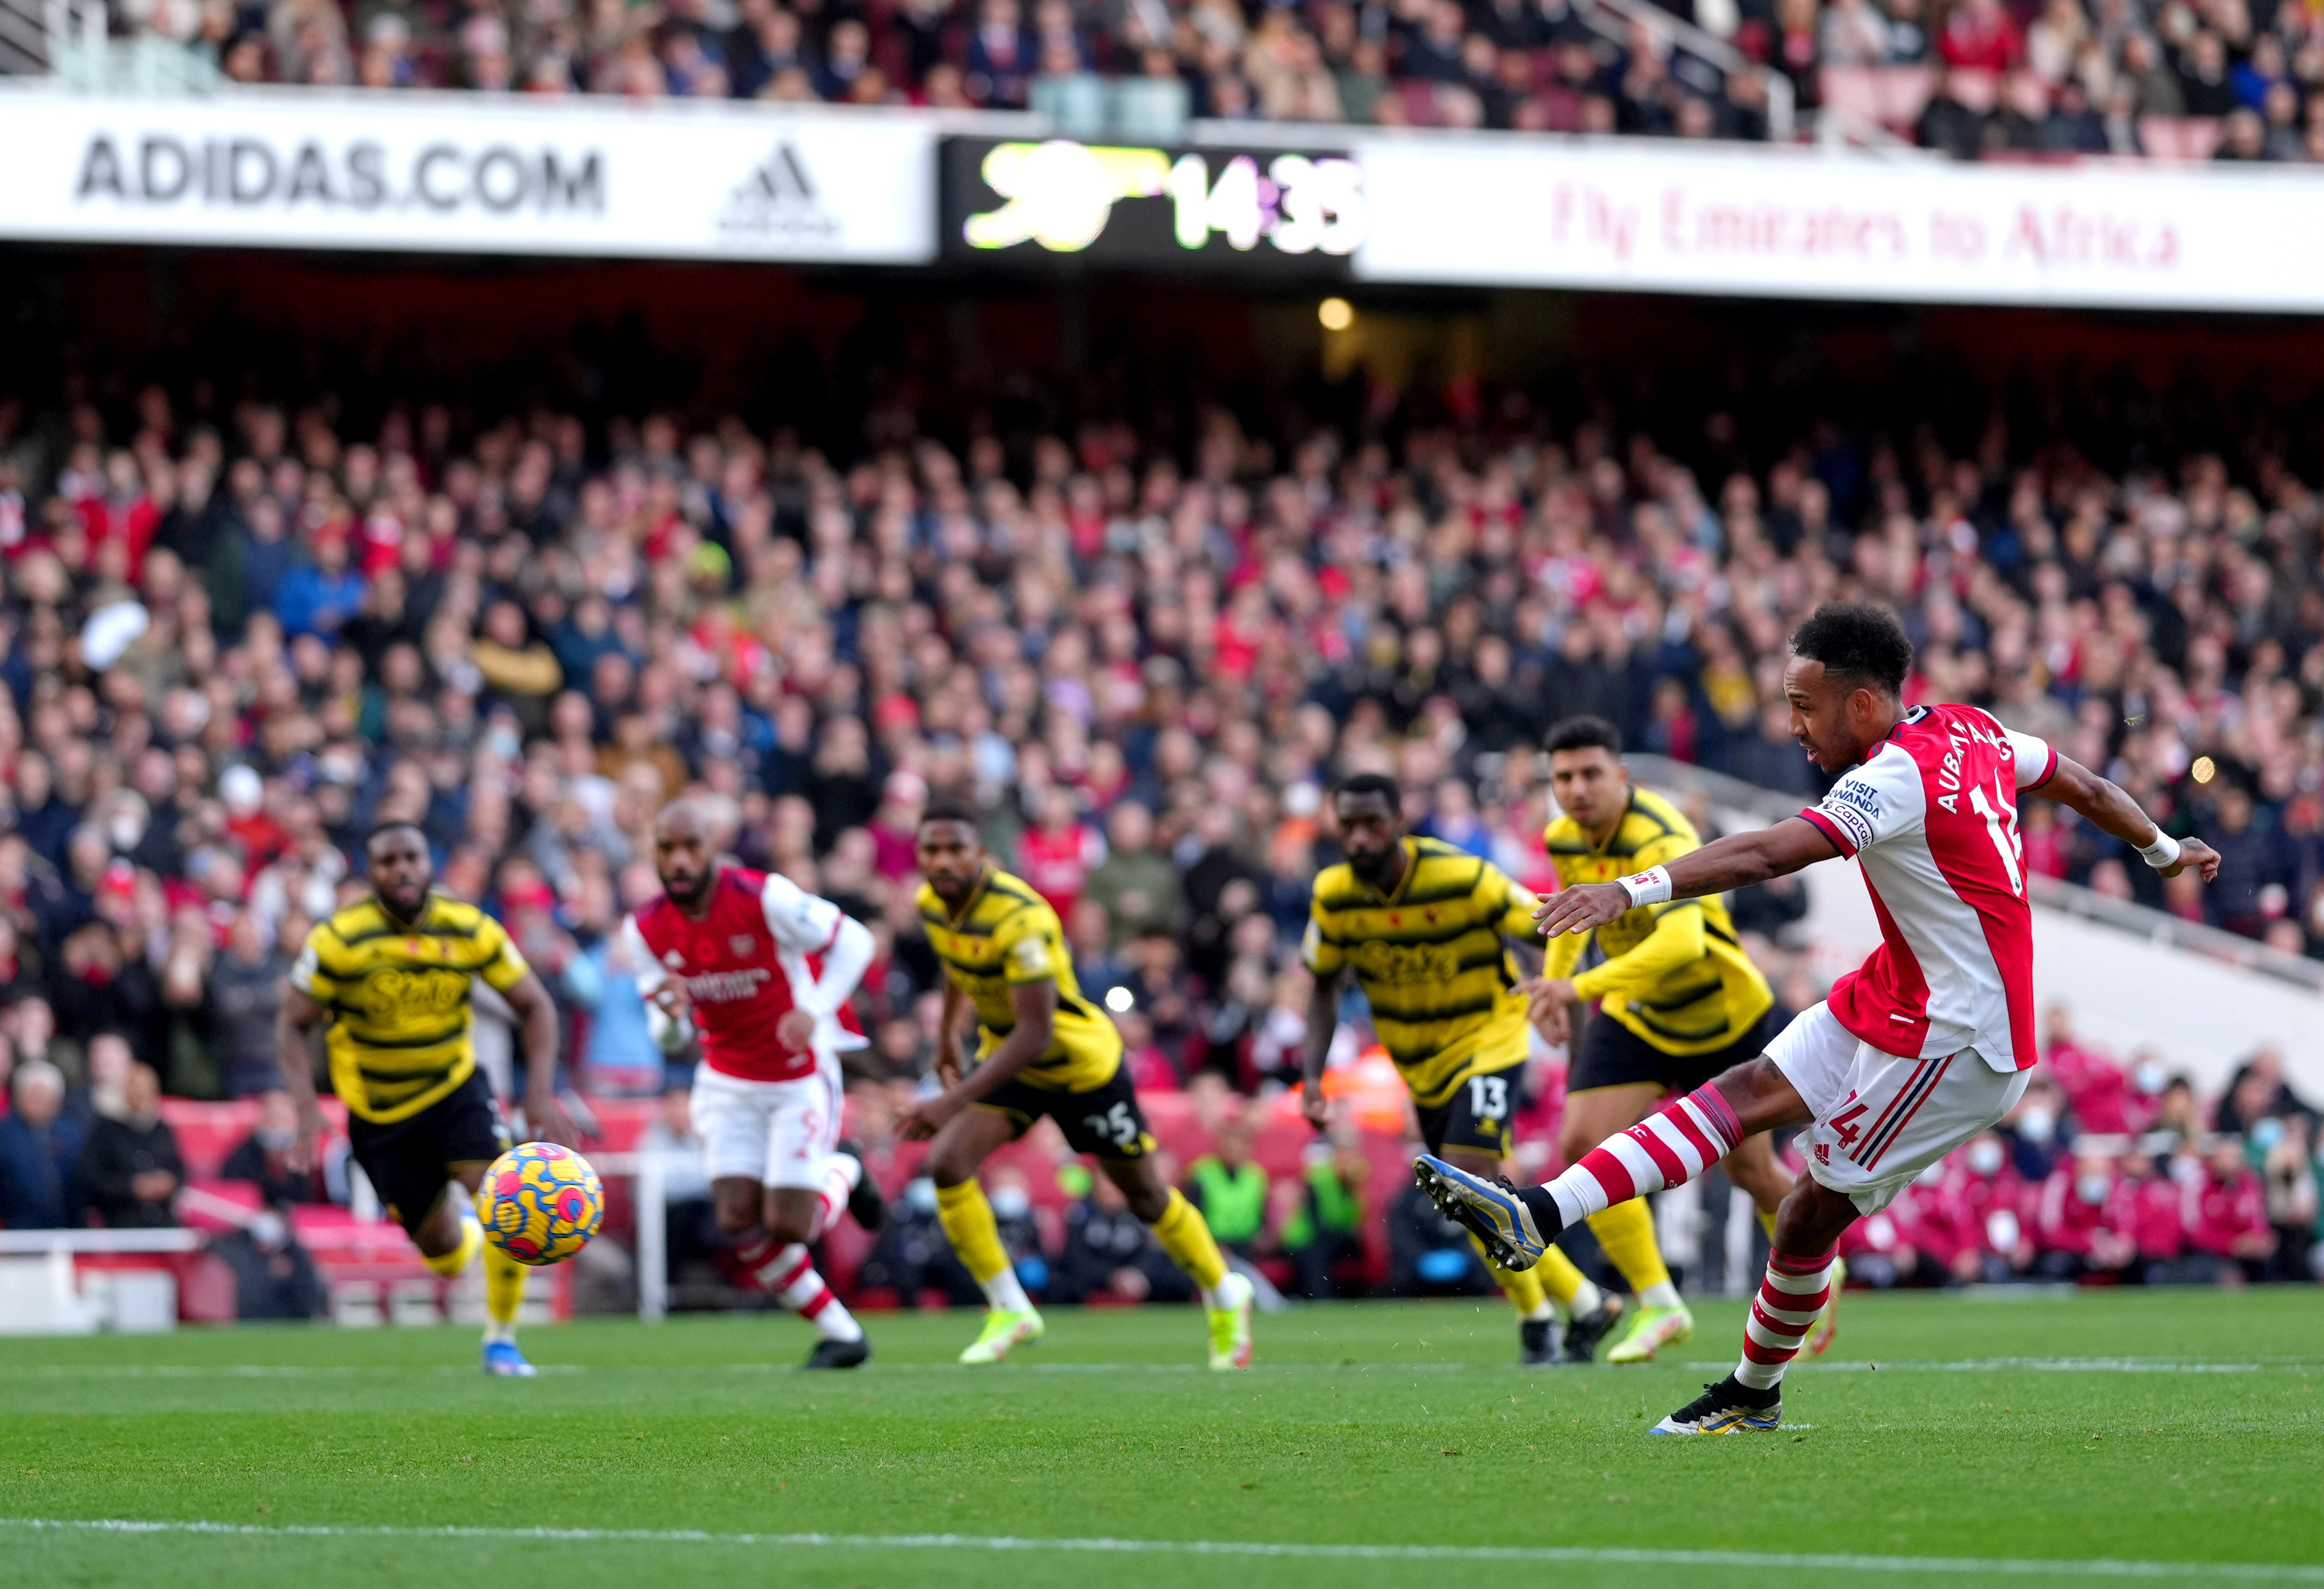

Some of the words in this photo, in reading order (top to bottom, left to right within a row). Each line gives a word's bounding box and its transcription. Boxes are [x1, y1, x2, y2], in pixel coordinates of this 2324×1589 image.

[76, 135, 607, 212] ADIDAS.COM
[1552, 183, 1639, 266] Fly
[1662, 188, 1906, 258] Emirates
[1931, 210, 1987, 261] to
[2006, 202, 2180, 269] Africa
[1827, 789, 1879, 819] RWANDA
[1845, 779, 1877, 799] VISIT
[1630, 873, 1649, 885] 14
[1467, 1075, 1508, 1119] 13
